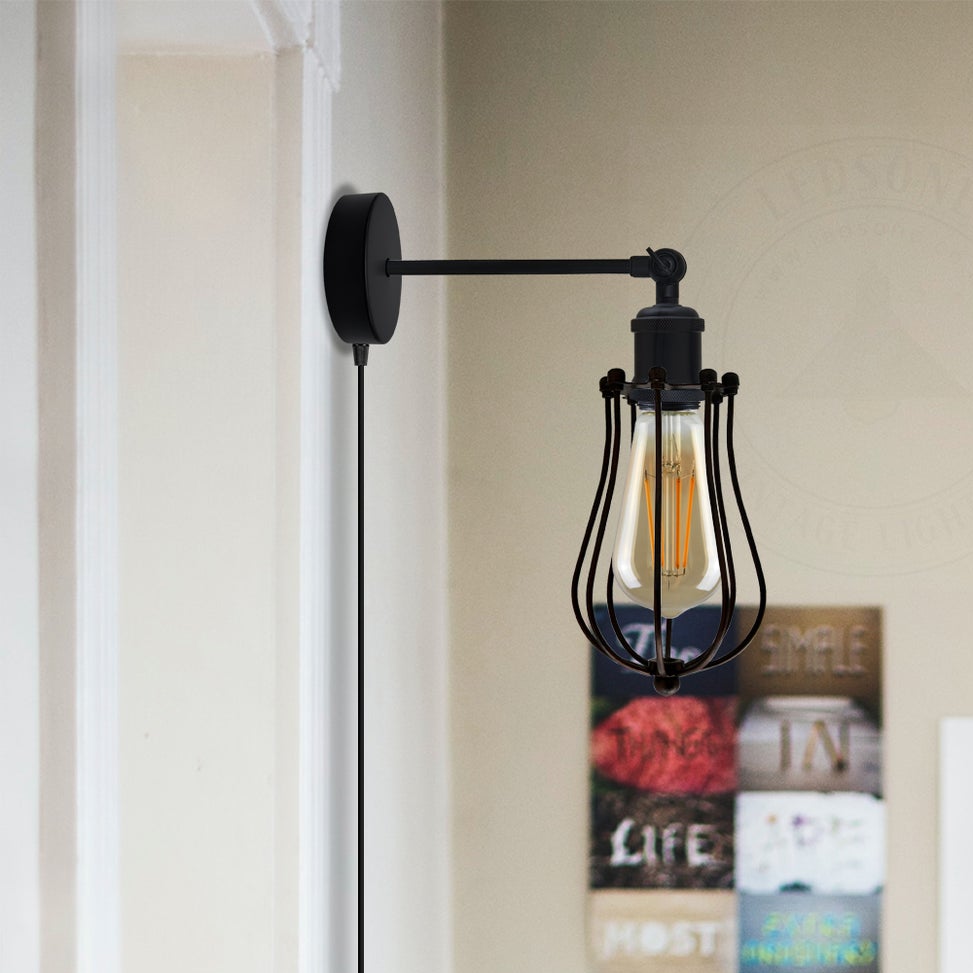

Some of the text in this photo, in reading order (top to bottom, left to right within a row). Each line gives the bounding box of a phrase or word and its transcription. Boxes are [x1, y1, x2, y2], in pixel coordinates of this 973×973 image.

[778, 718, 852, 773] IN
[609, 817, 718, 867] LIFE
[602, 920, 719, 960] MOST
